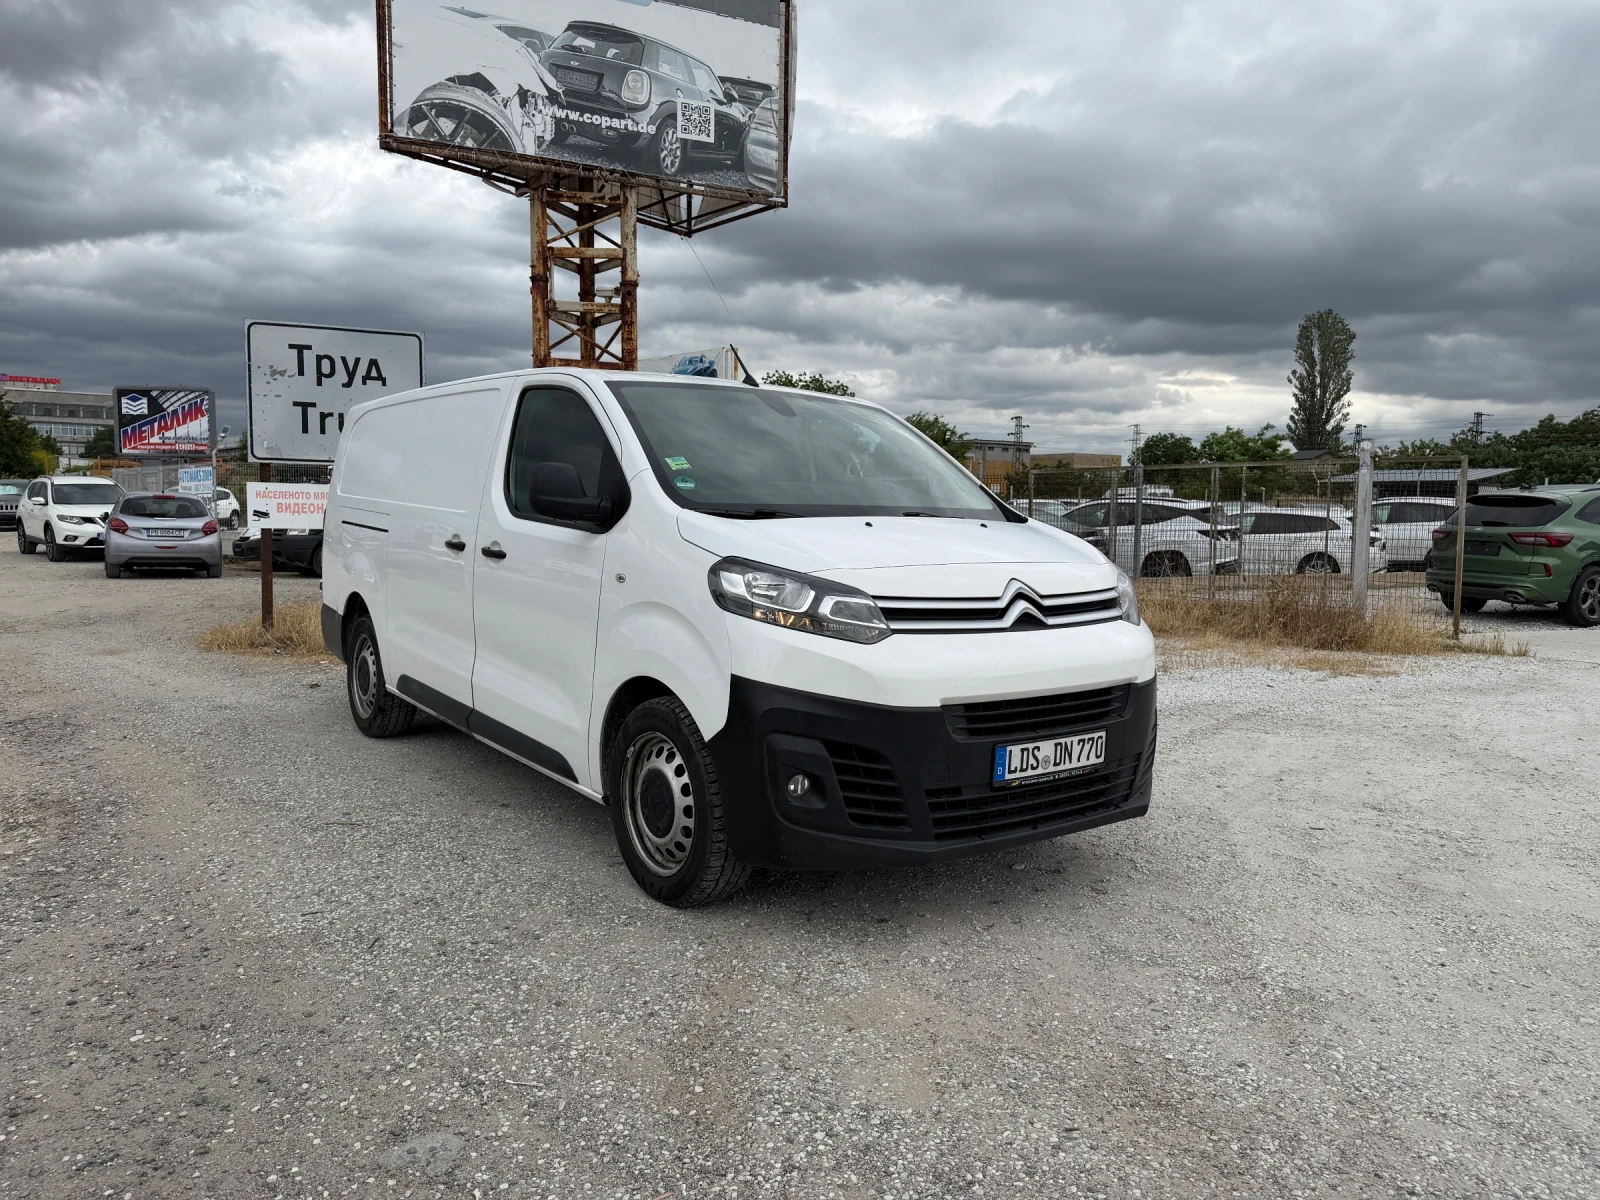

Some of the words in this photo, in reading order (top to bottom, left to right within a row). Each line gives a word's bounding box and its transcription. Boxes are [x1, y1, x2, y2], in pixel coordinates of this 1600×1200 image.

[542, 105, 657, 134] www.copart.de
[288, 343, 387, 388] Труд
[121, 396, 207, 450] МЕТАЛИК
[175, 443, 196, 451] 1989
[255, 490, 311, 500] НАСЕЛЕНОТО
[1007, 745, 1041, 775] LDS
[1052, 740, 1074, 767] DN
[1077, 735, 1104, 763] 770
